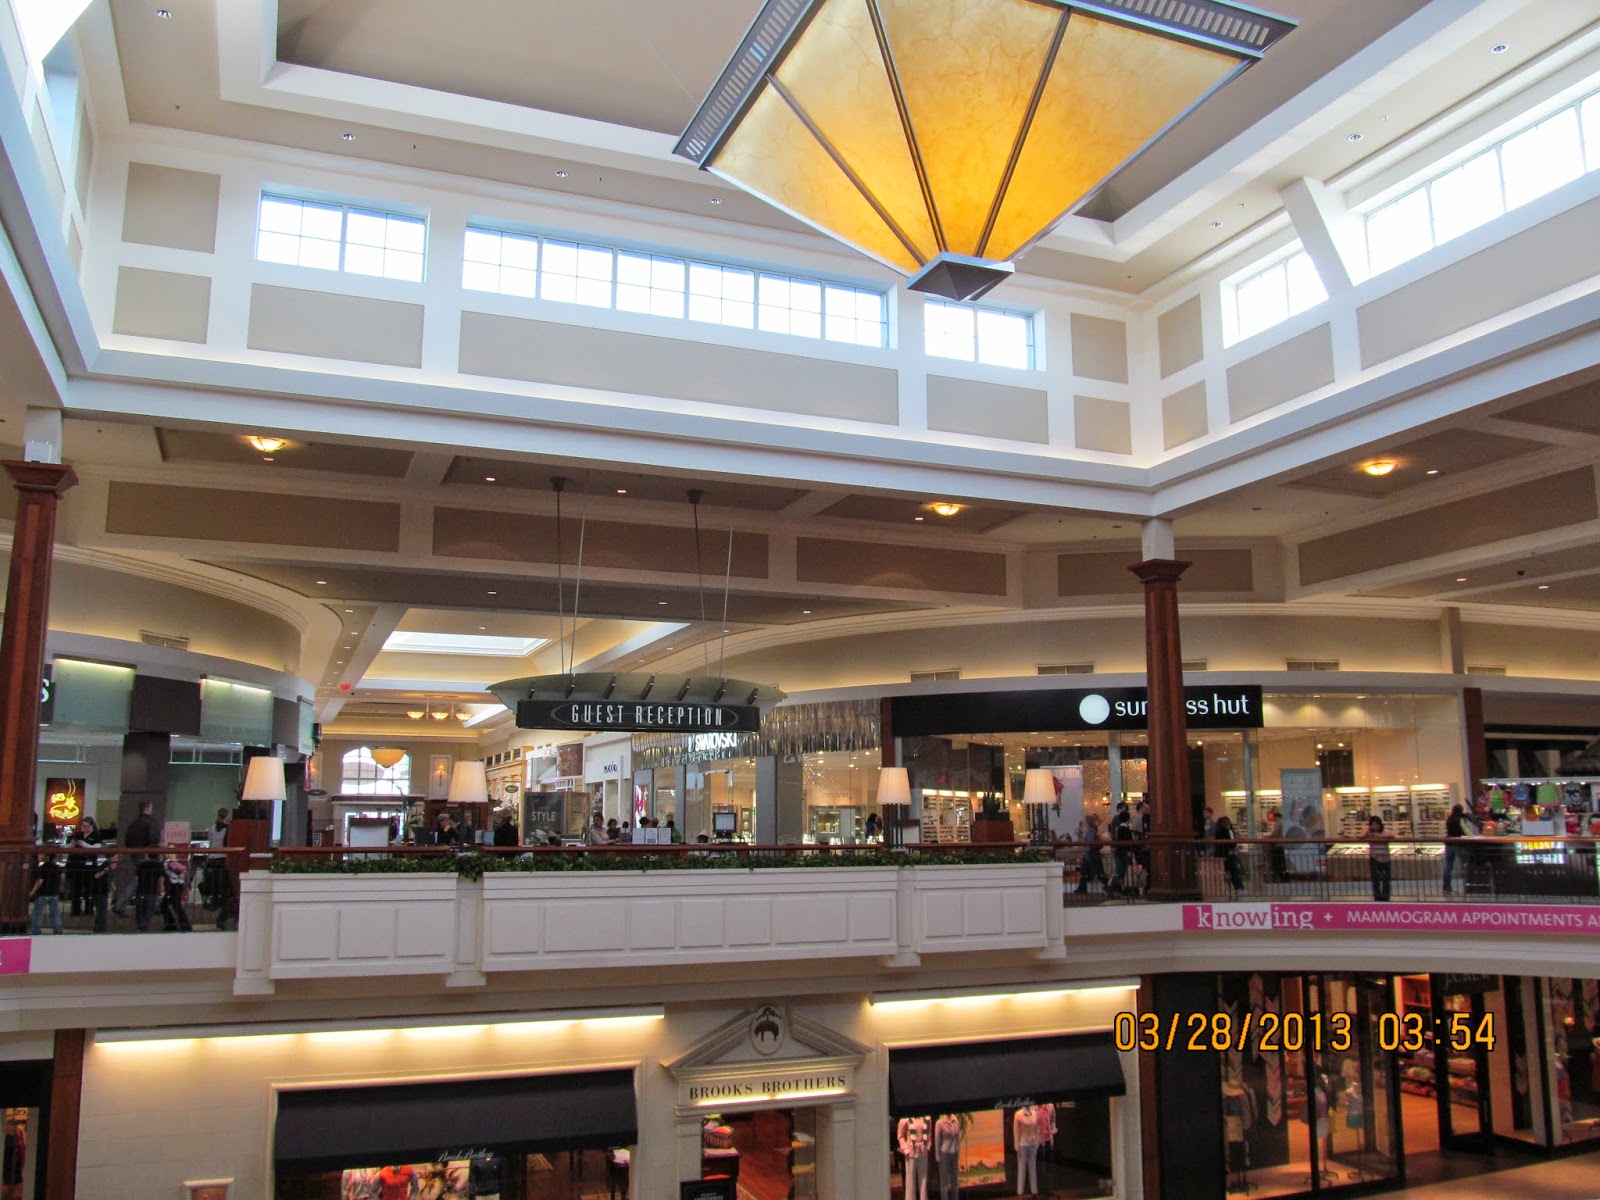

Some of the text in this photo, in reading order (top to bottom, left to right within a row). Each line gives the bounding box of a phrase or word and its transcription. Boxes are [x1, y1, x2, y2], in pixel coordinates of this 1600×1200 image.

[572, 704, 722, 726] GUEST RECEPTION
[1213, 693, 1249, 715] hut
[694, 732, 737, 752] SWAROVSKI
[531, 811, 557, 821] STYLE
[1197, 906, 1314, 930] knowing
[1347, 910, 1457, 924] MAMMOGRAM
[1461, 911, 1583, 927] APPOINTMENTS
[689, 1075, 846, 1100] BROOKS BROTHERS
